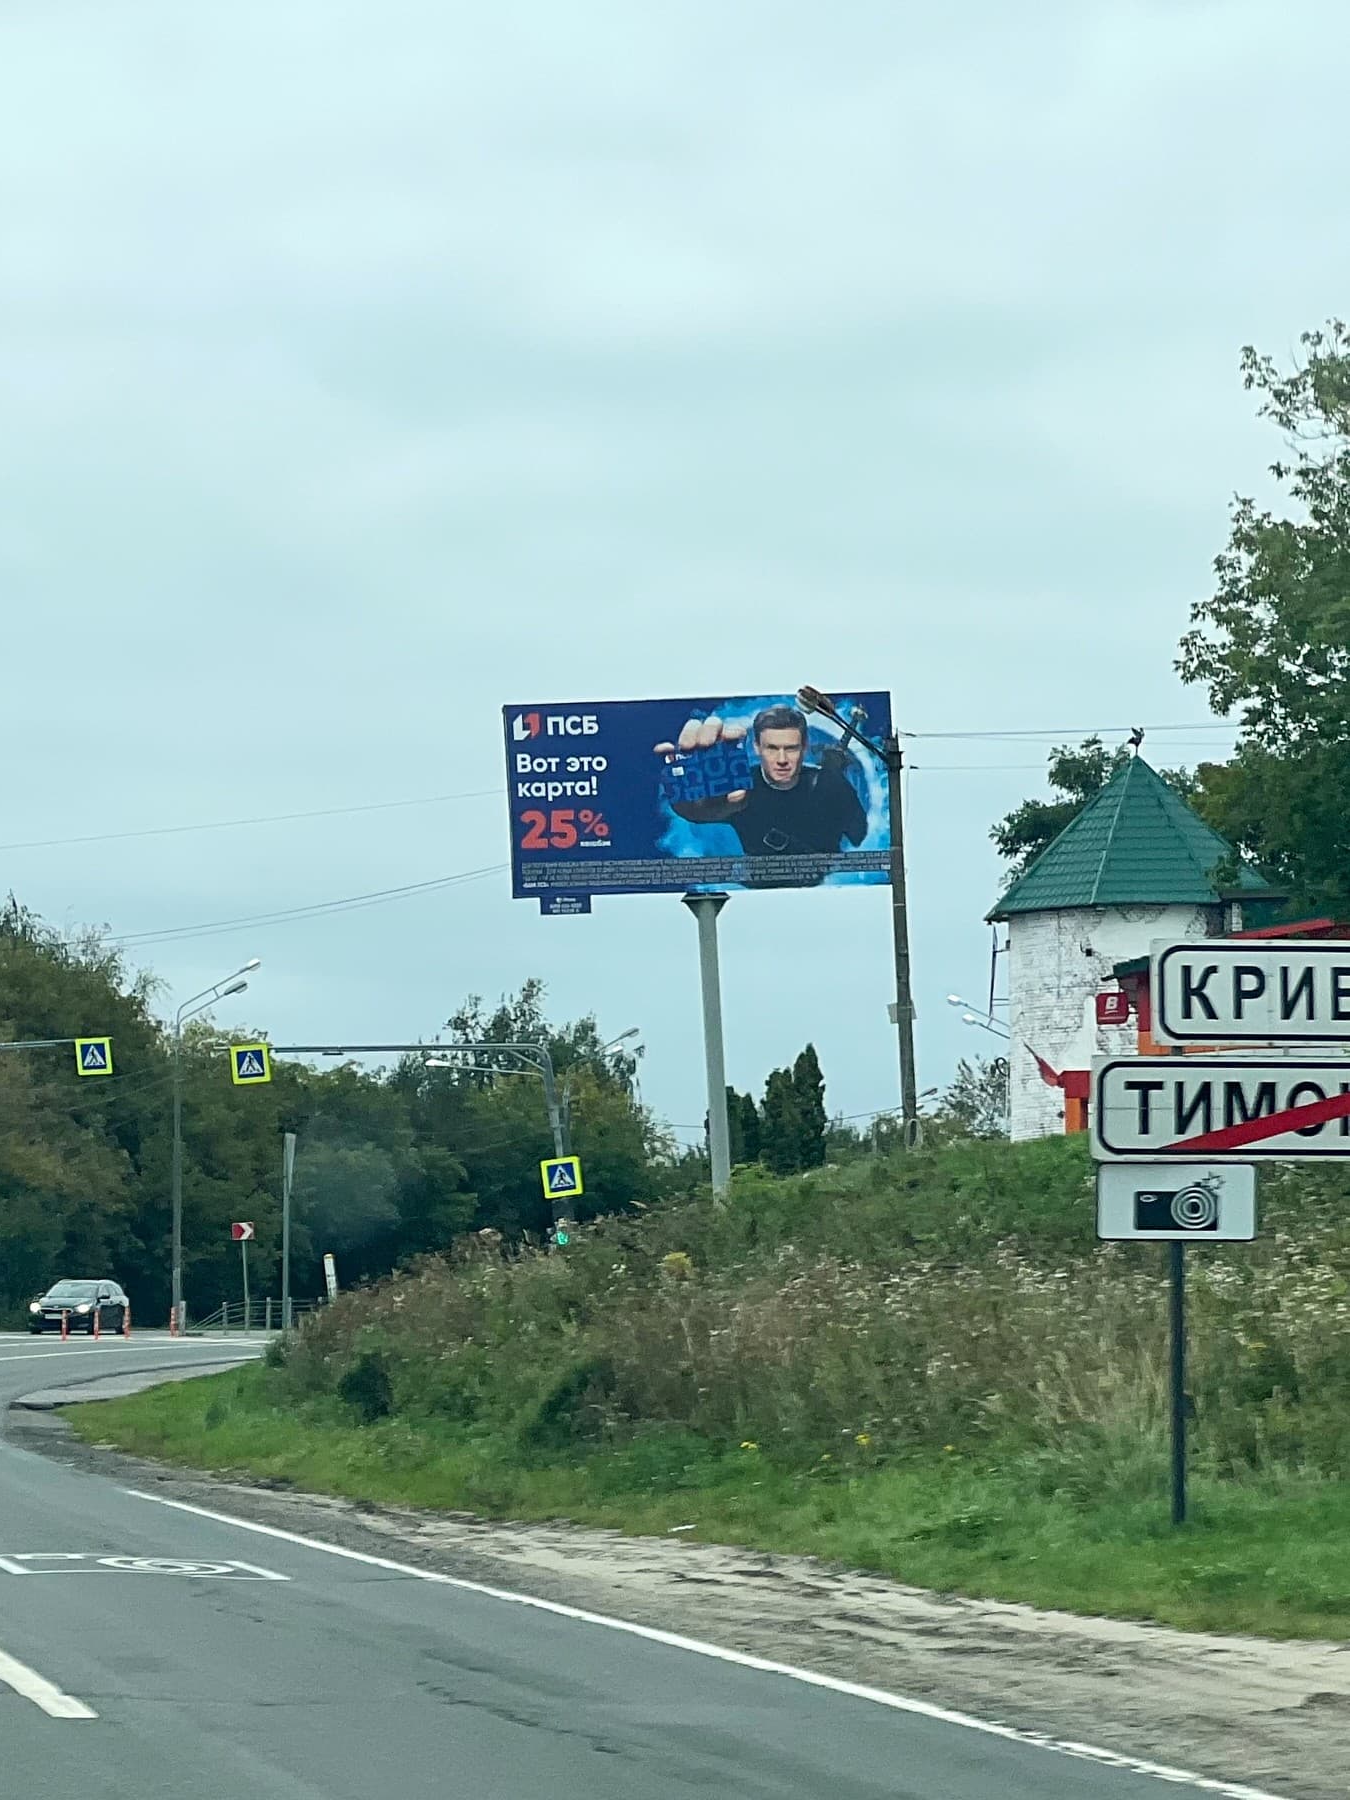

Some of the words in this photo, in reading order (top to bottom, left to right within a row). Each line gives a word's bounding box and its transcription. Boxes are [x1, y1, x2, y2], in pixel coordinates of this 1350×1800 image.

[546, 715, 599, 736] ПСБ
[516, 753, 560, 773] Вот
[566, 756, 608, 772] это
[517, 775, 598, 802] карта!
[520, 809, 609, 849] 25%
